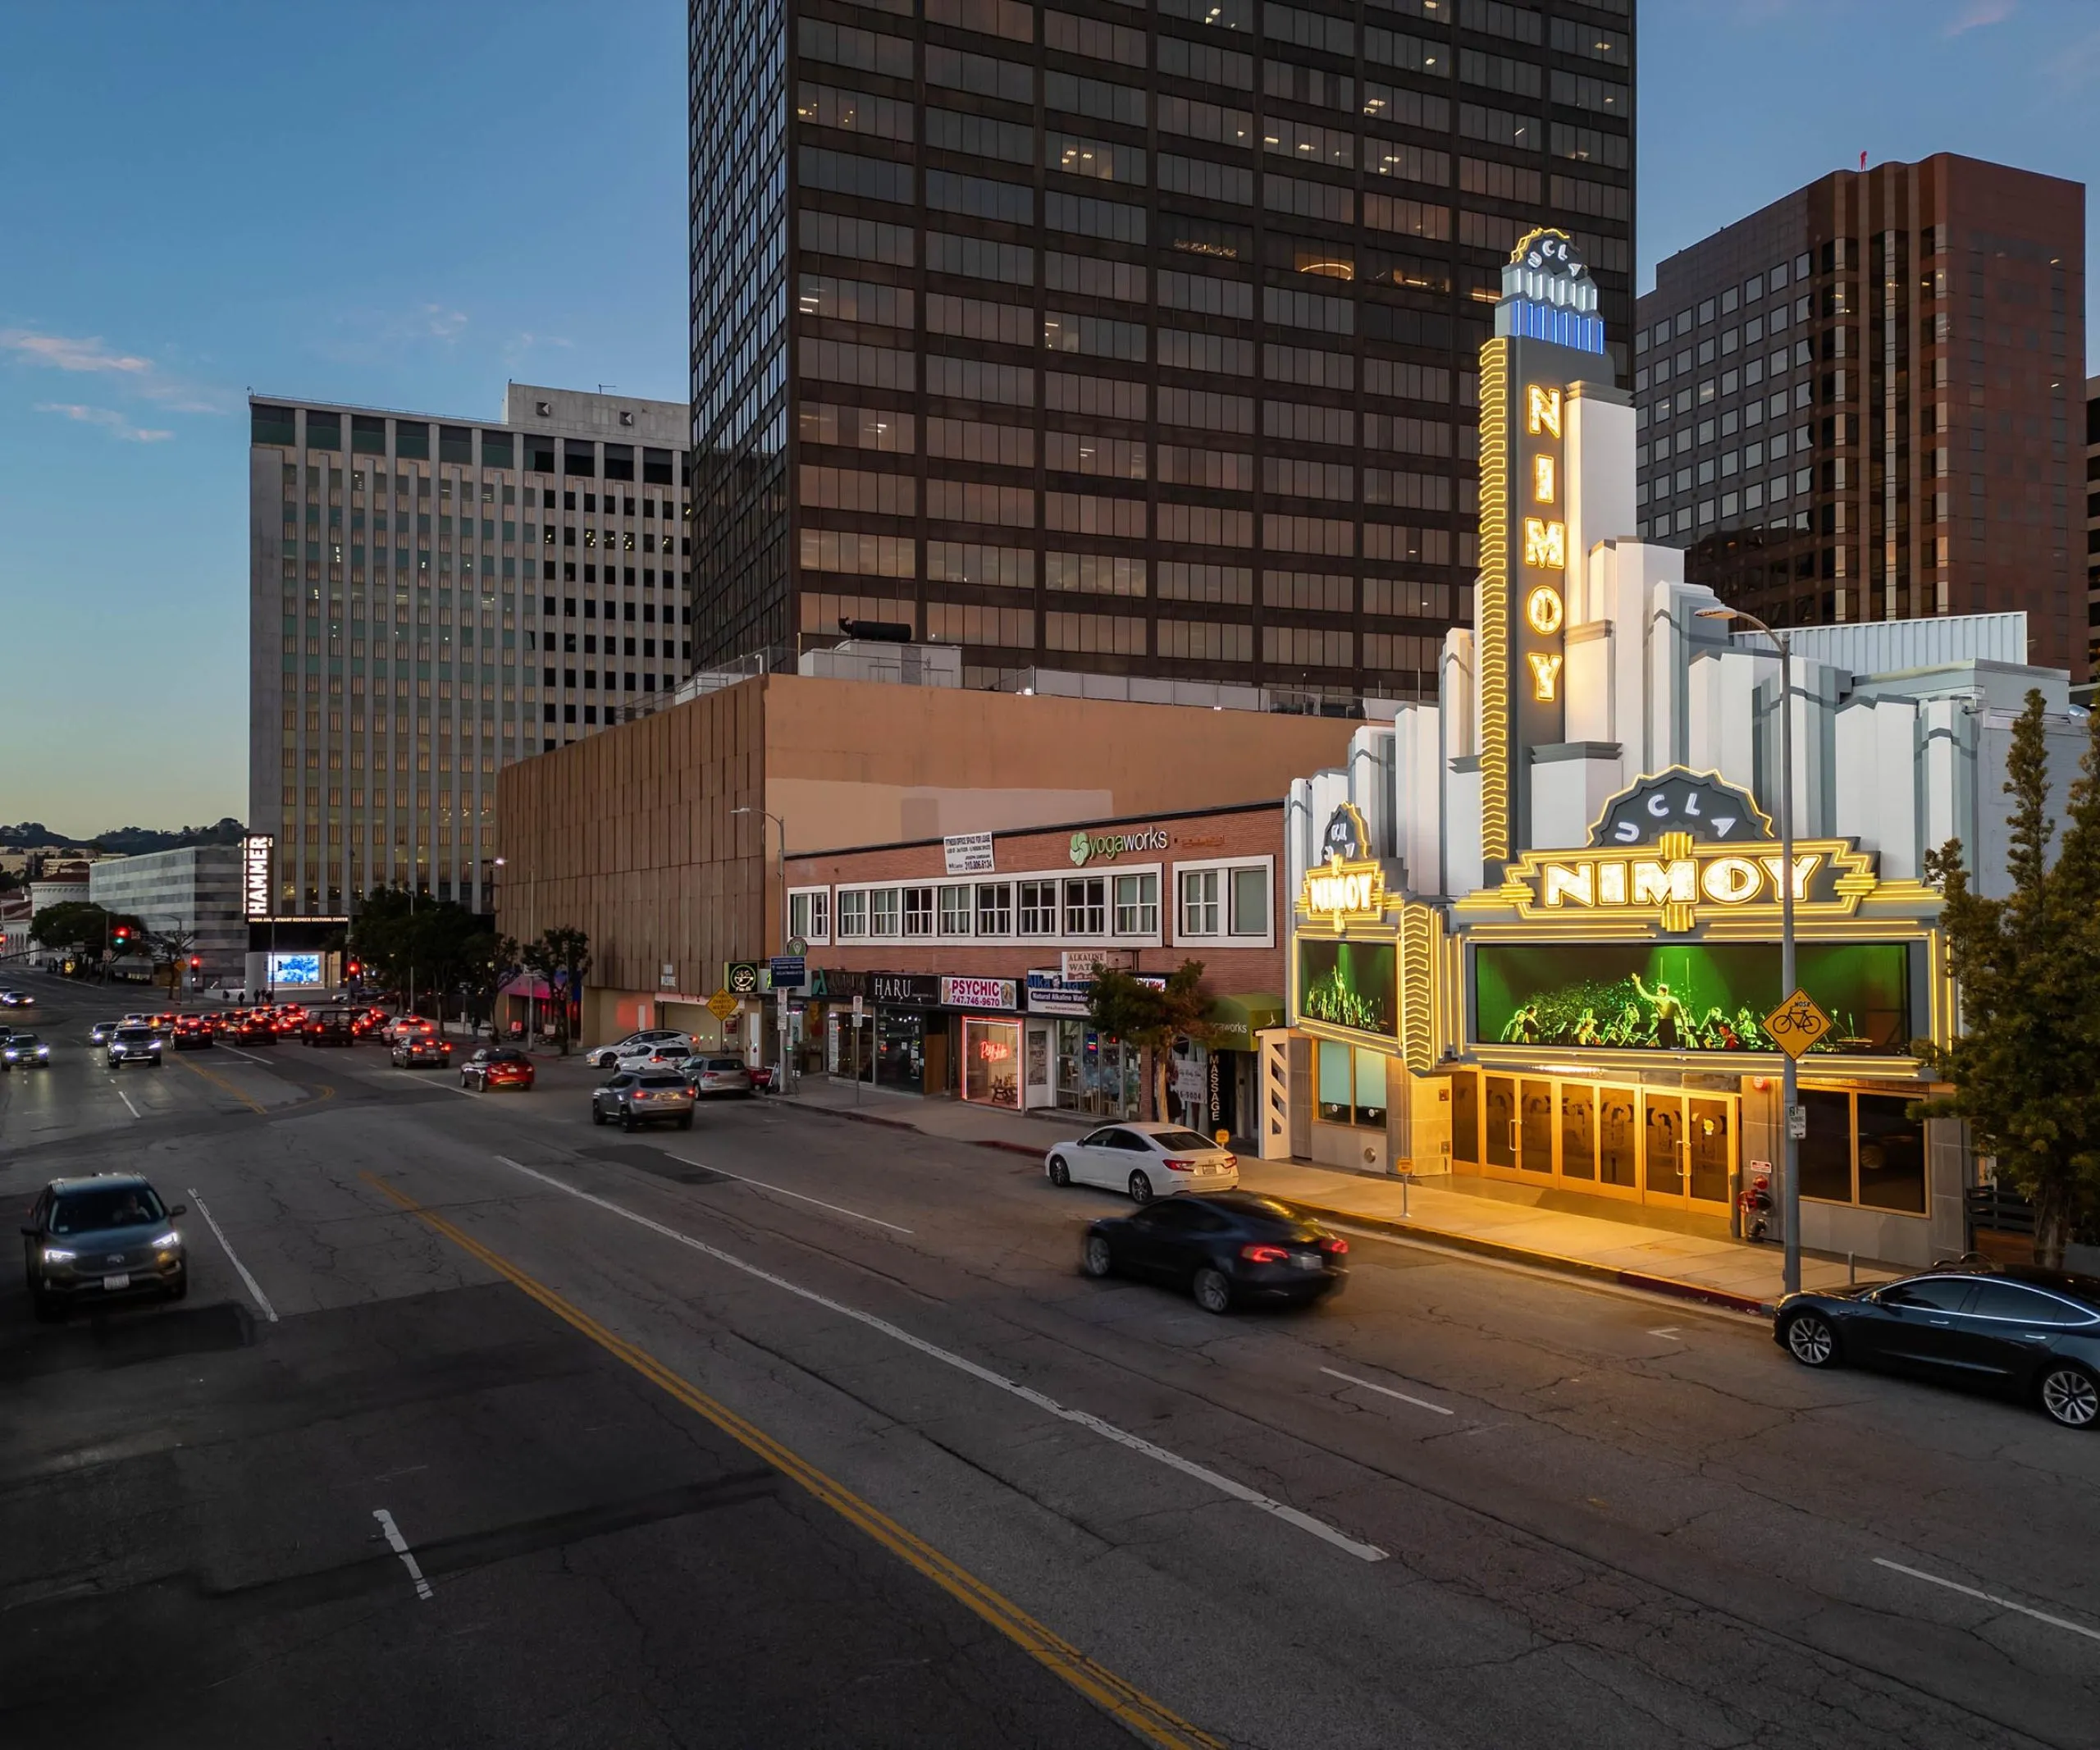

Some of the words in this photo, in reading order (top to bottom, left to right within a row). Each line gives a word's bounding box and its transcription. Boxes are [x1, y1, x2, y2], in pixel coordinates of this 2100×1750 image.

[1527, 240, 1582, 276] UCLA
[1524, 385, 1565, 701] NIMOY
[1614, 793, 1737, 843] UCLA
[1089, 825, 1168, 860] yogaworks
[249, 836, 267, 914] HAMMER
[1310, 872, 1372, 913] NIMOY
[1545, 854, 1822, 908] NIMOY
[874, 978, 911, 998] HARU
[952, 980, 1000, 996] PSYCHIC
[1032, 993, 1051, 1001] Natural
[1052, 993, 1072, 1001] Alkaline
[1209, 1054, 1221, 1122] MASSAGE
